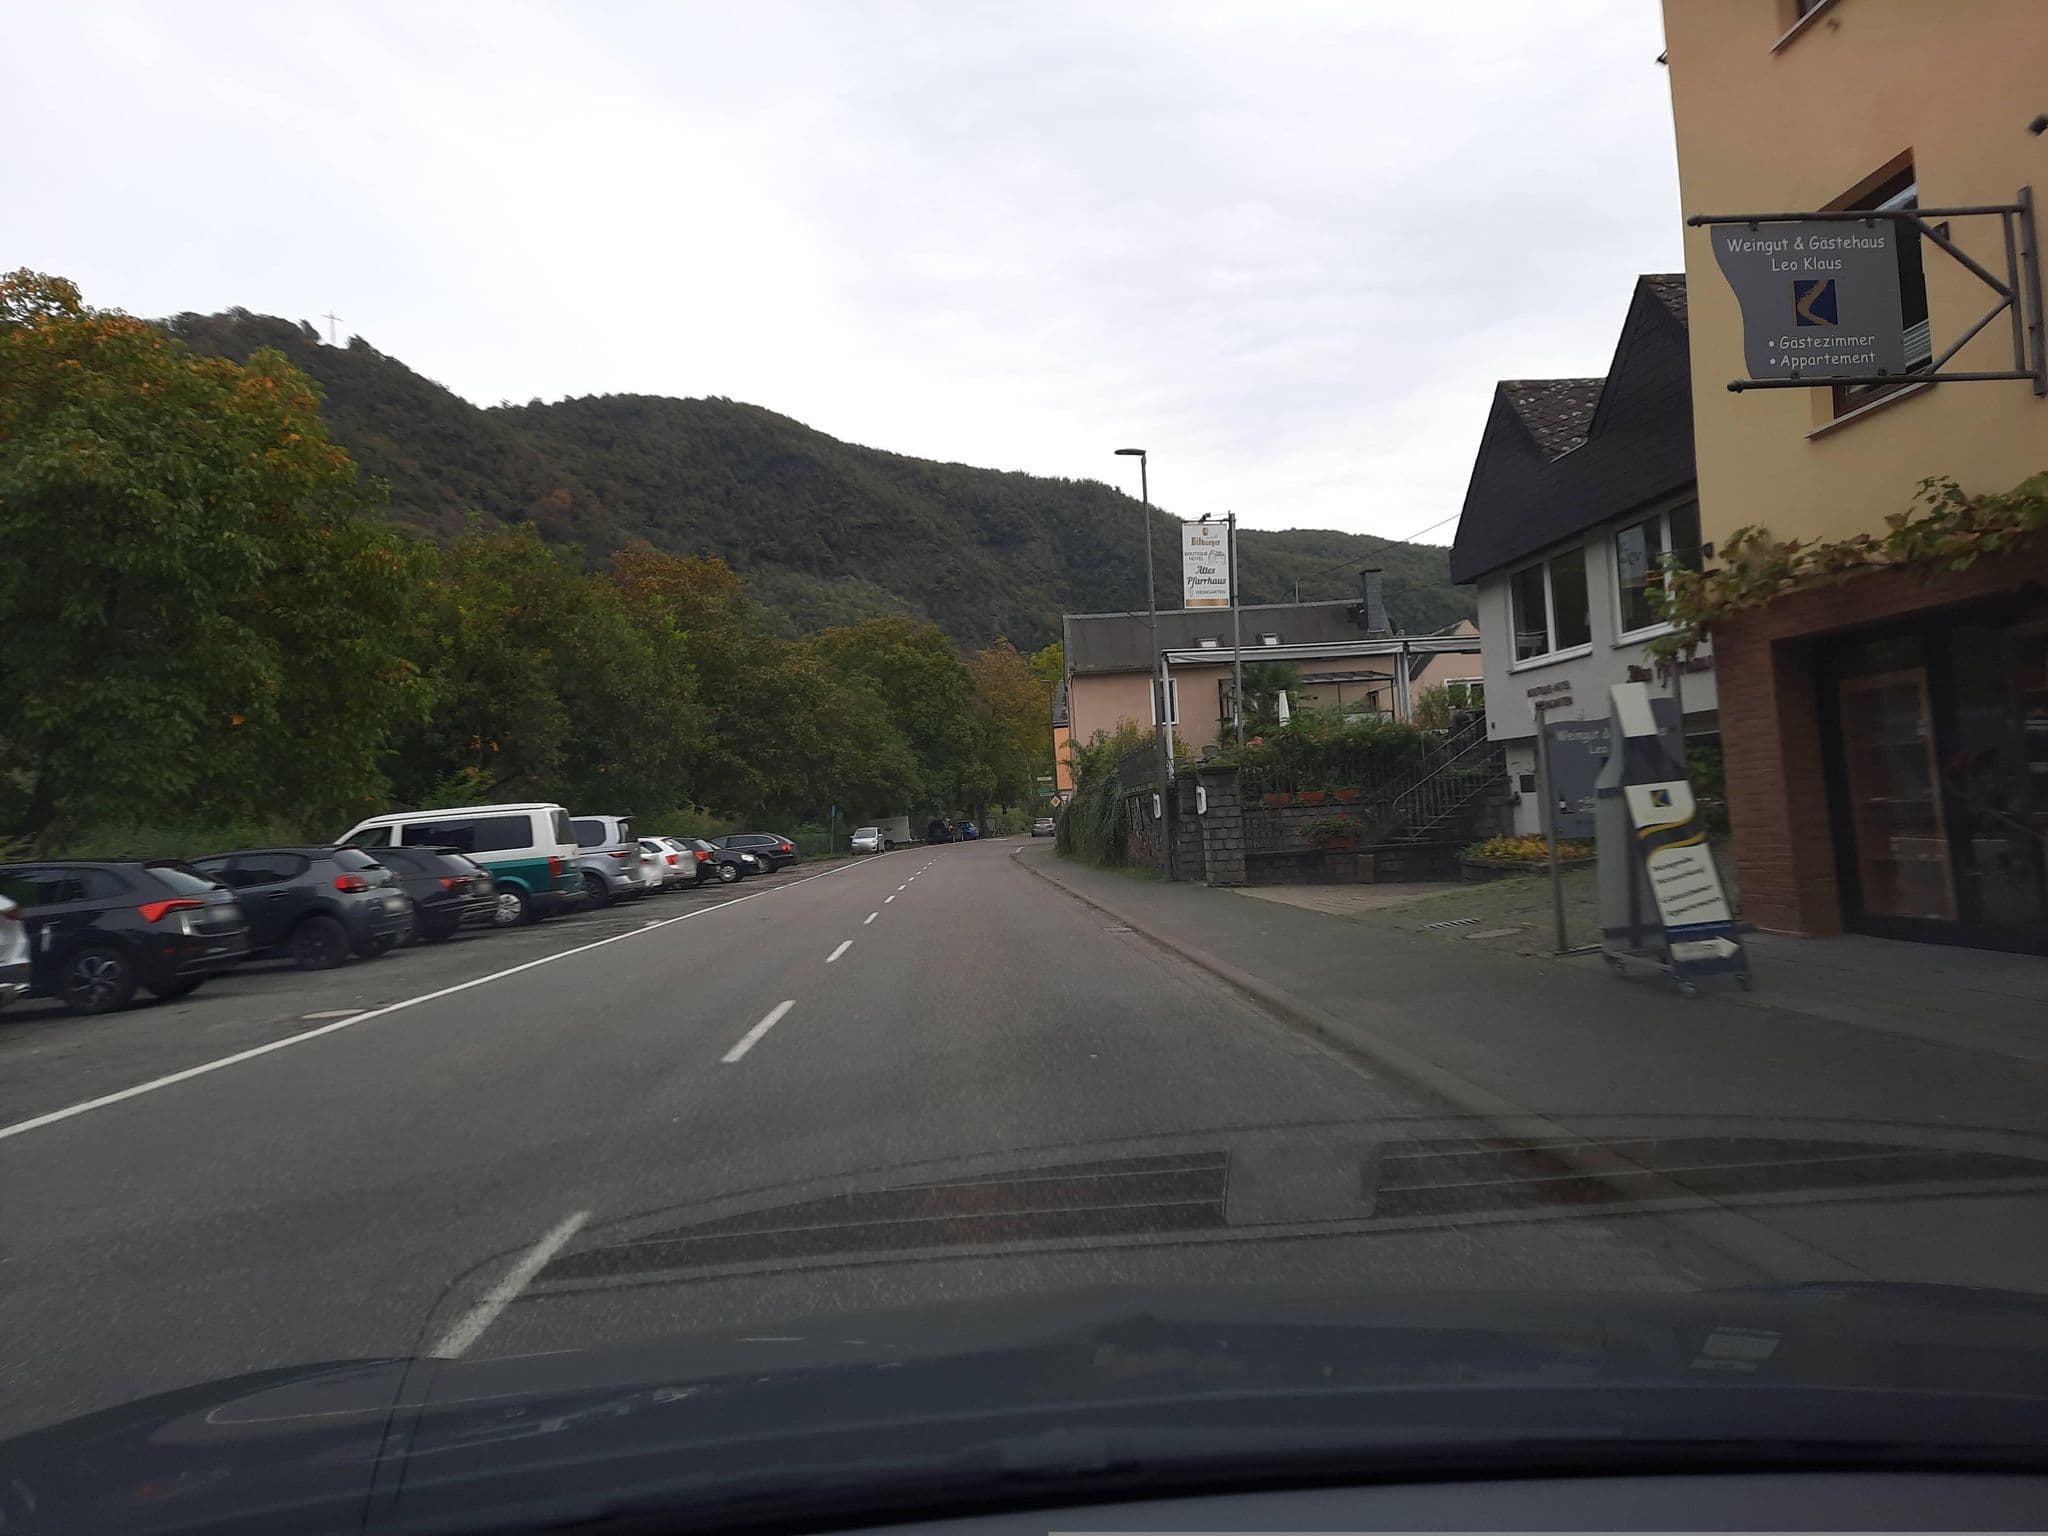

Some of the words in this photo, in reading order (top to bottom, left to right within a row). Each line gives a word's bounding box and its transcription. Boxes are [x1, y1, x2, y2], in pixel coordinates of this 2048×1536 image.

[1726, 238, 1789, 255] Weingut
[1794, 236, 1805, 250] &
[1809, 235, 1885, 250] Gästehaus
[1771, 258, 1798, 271] Leo
[1803, 256, 1842, 271] Klaus
[1780, 335, 1875, 349] Gästezimmer
[1780, 352, 1876, 370] Appartement
[1195, 565, 1216, 574] Altes
[1186, 576, 1227, 589] Pfarrhaus
